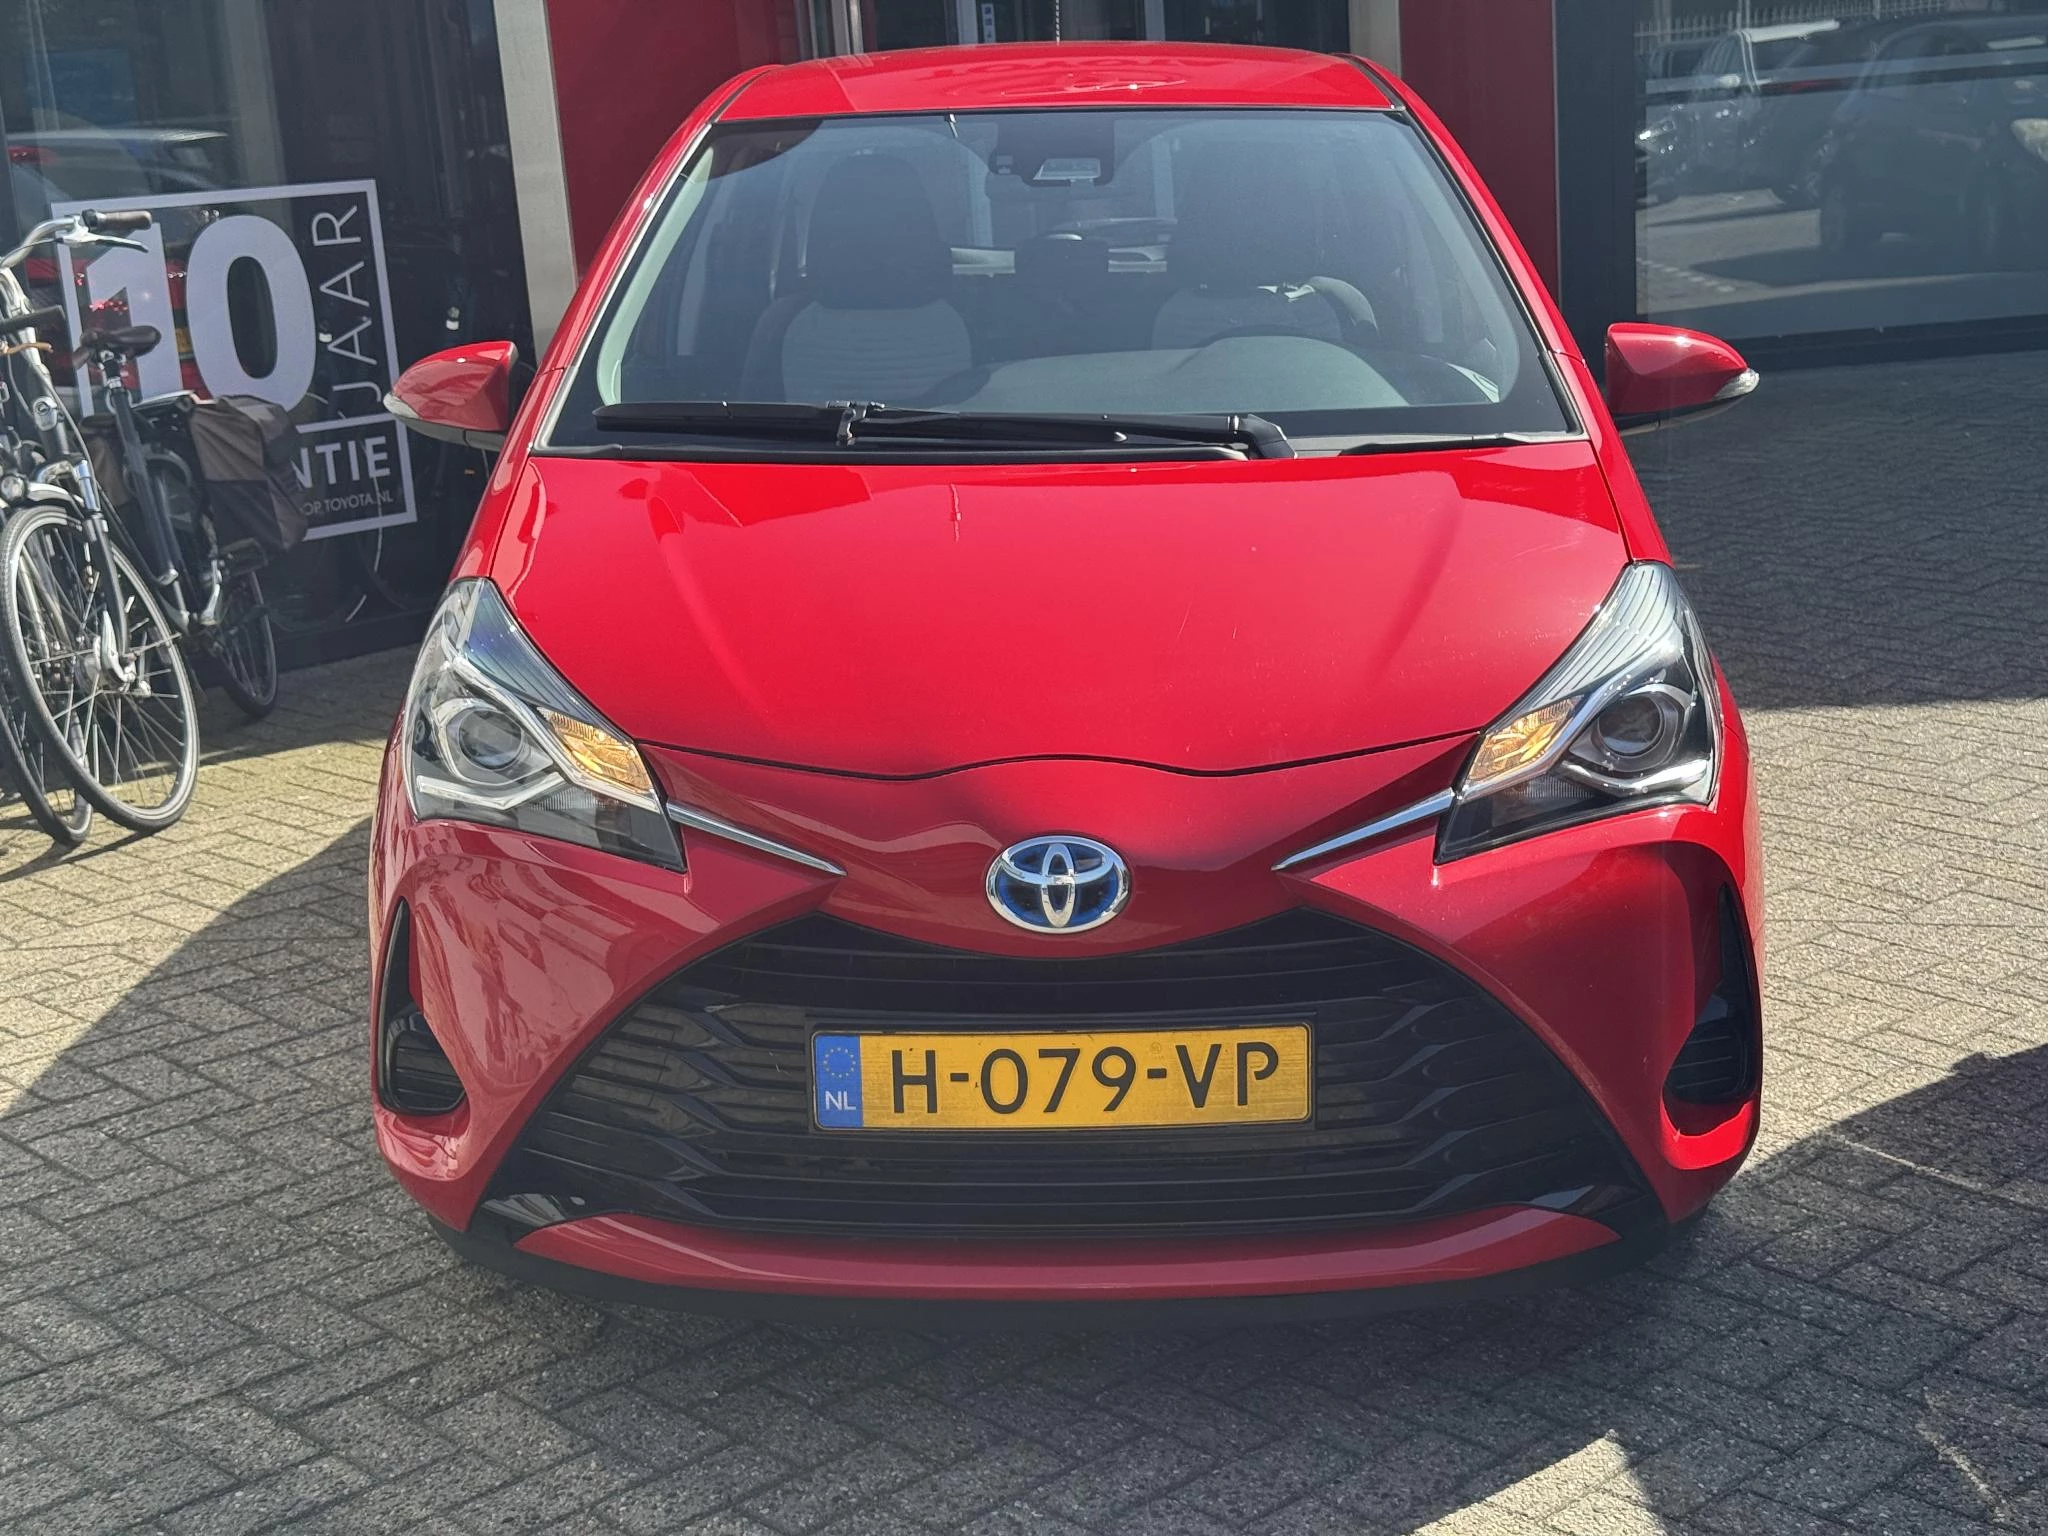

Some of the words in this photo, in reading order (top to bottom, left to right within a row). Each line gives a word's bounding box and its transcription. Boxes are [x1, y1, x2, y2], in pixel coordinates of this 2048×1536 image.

[86, 214, 316, 413] 10
[311, 205, 382, 403] JAAR
[290, 436, 391, 489] NTIE
[325, 490, 394, 513] TOYOTA.NL
[825, 1090, 857, 1112] NL
[891, 1041, 1280, 1115] H-079-VP
